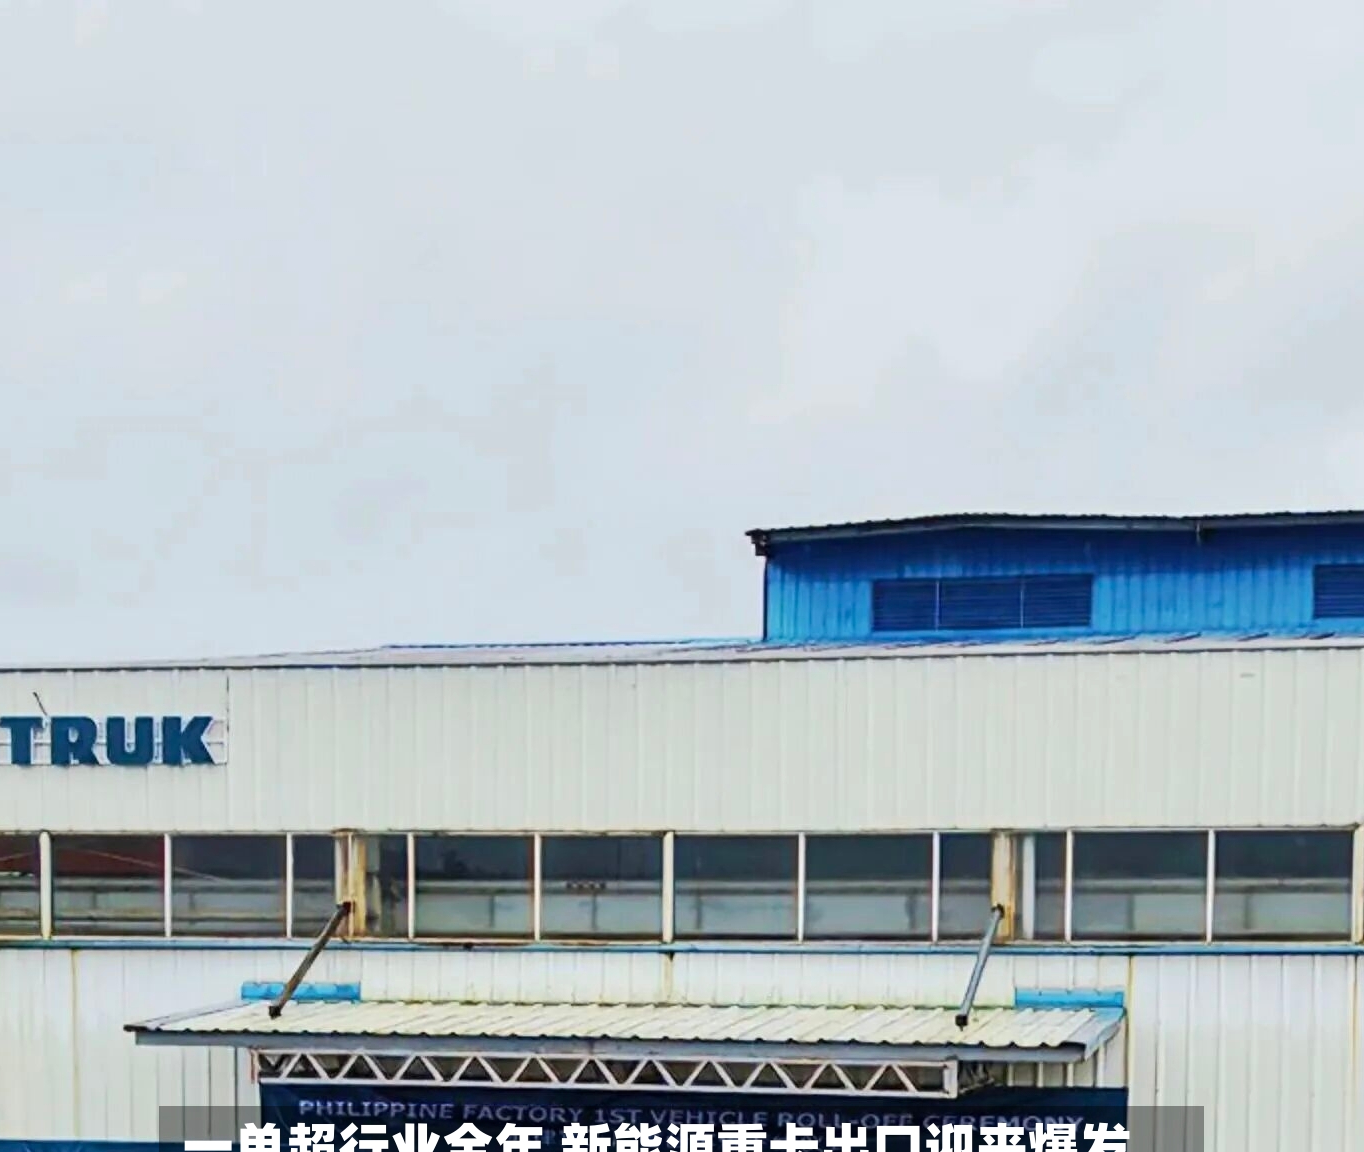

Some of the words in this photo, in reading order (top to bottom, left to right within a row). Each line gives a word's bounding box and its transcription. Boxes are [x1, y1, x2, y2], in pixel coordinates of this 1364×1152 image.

[298, 1100, 453, 1119] PHILIPPINE
[462, 1104, 584, 1123] FACTORY
[594, 1107, 643, 1124] 1ST
[649, 1109, 768, 1126] VEHICLE
